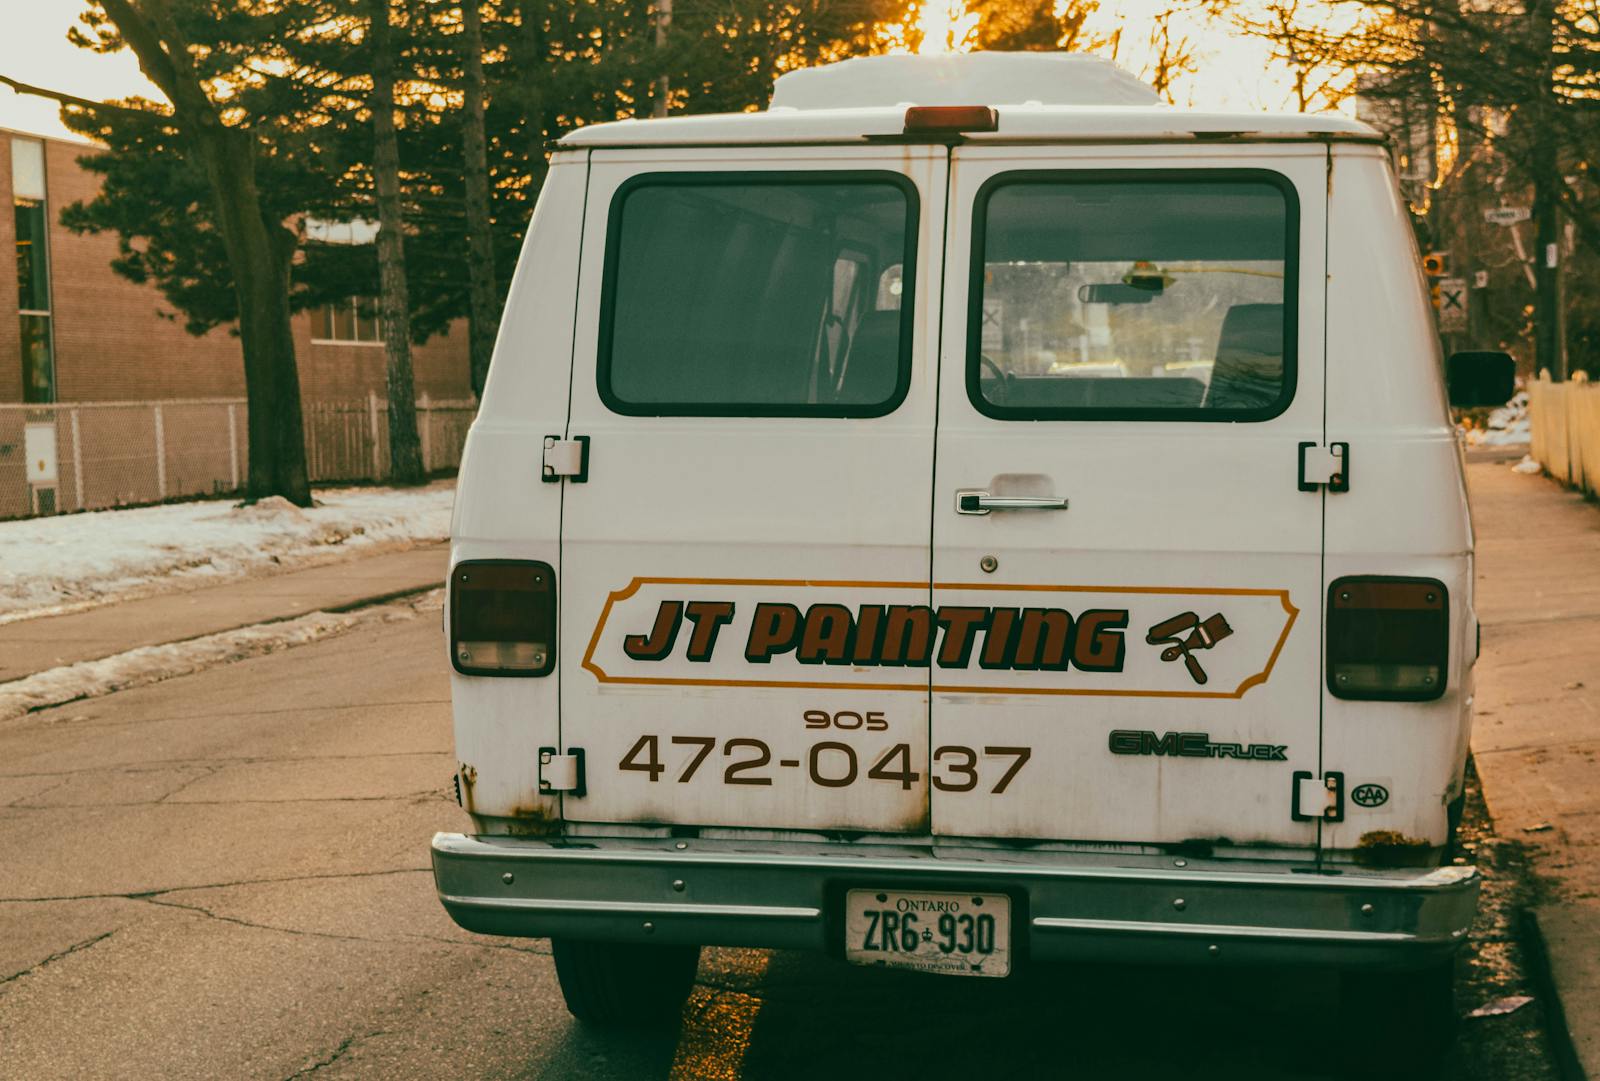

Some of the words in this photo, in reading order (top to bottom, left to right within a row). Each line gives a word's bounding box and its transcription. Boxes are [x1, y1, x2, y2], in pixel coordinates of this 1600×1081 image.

[624, 601, 735, 662] JT
[746, 602, 1129, 672] PAINTING
[804, 710, 889, 732] 905
[1109, 730, 1208, 758] GMC
[1204, 742, 1288, 761] TRUCK
[619, 735, 1032, 795] 472-0437
[1355, 788, 1383, 803] CAA
[896, 898, 960, 912] ONTARIO
[863, 911, 919, 952] ZR6
[938, 914, 995, 955] 930
